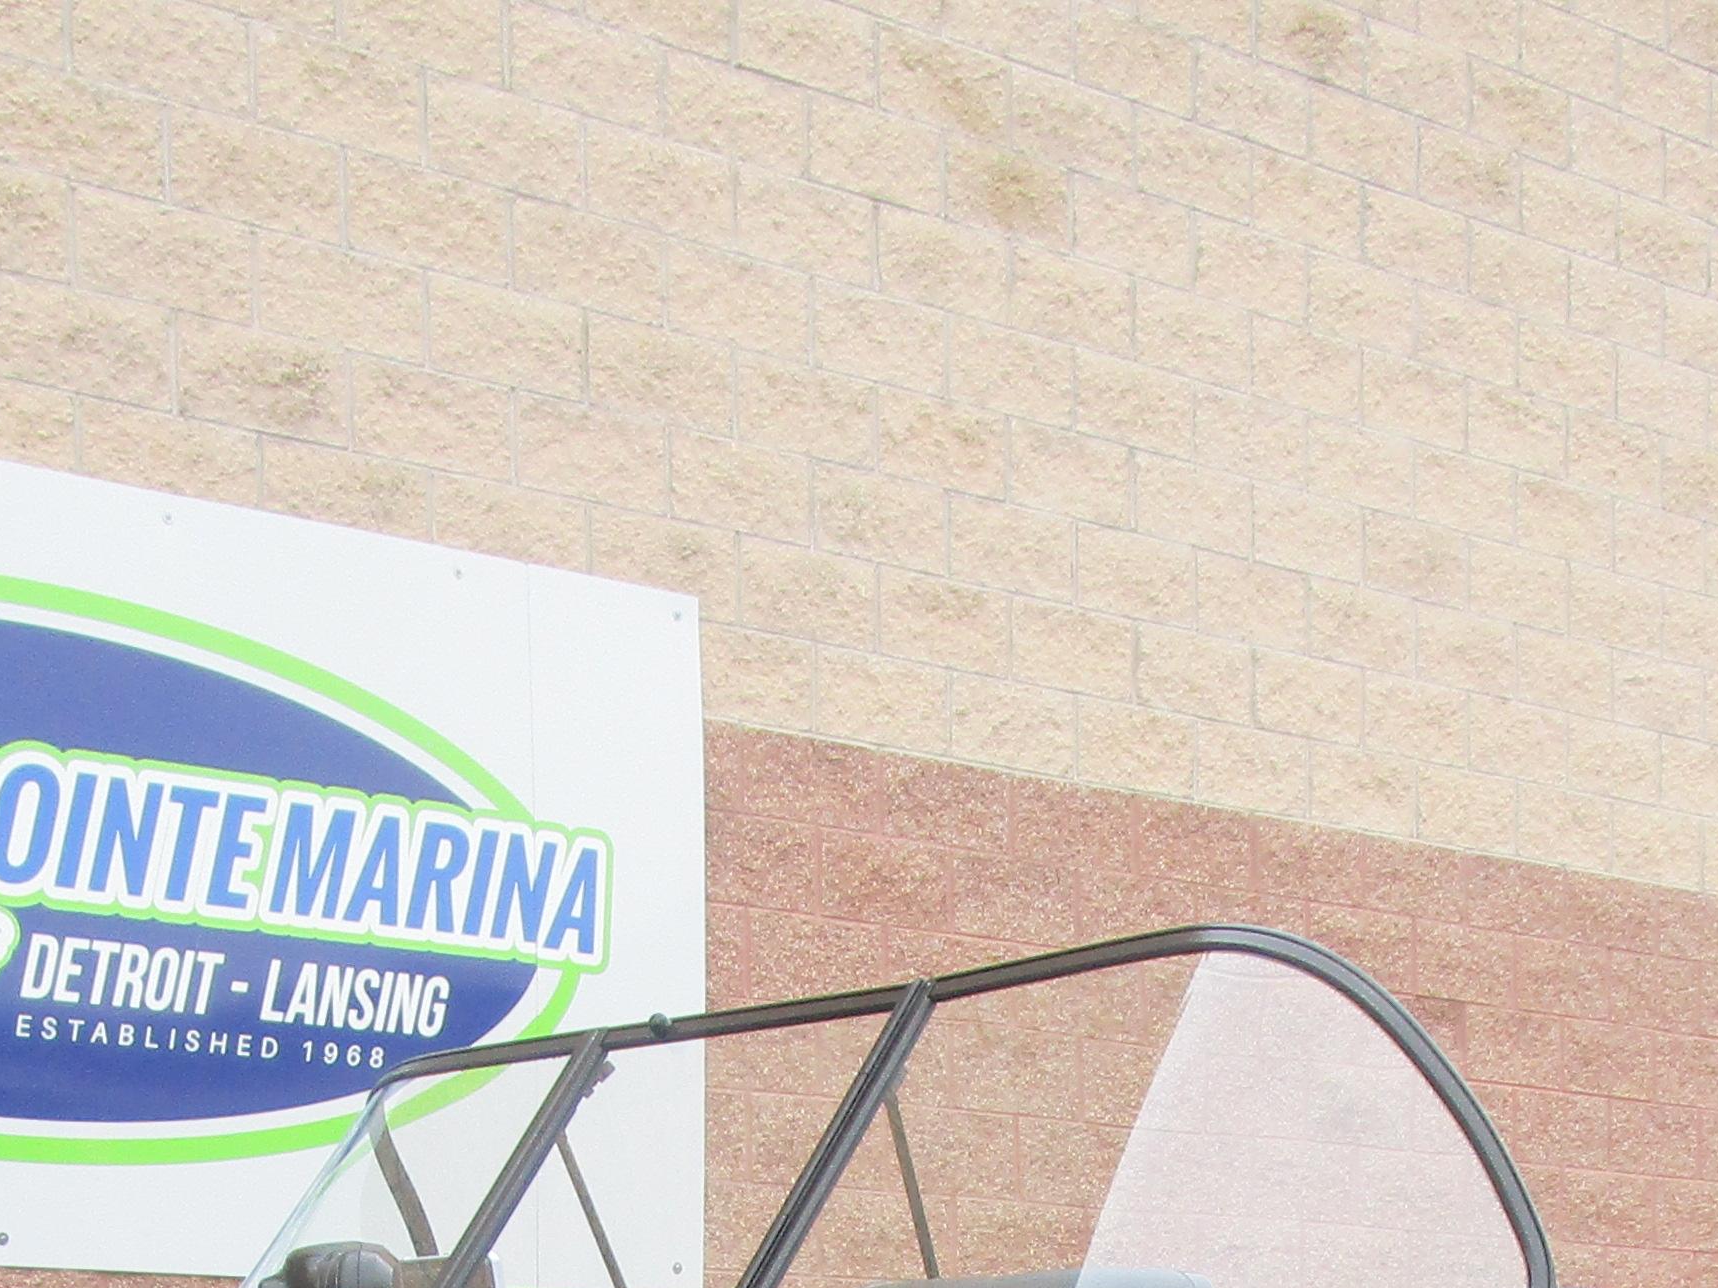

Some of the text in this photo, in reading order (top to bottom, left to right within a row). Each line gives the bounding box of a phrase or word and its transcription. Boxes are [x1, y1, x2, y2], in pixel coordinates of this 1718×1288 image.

[269, 802, 599, 956] MARINA
[18, 932, 226, 1015] DETROIT
[258, 958, 450, 1038] LANSING
[15, 1014, 385, 1069] ESTABLISHED 1968
